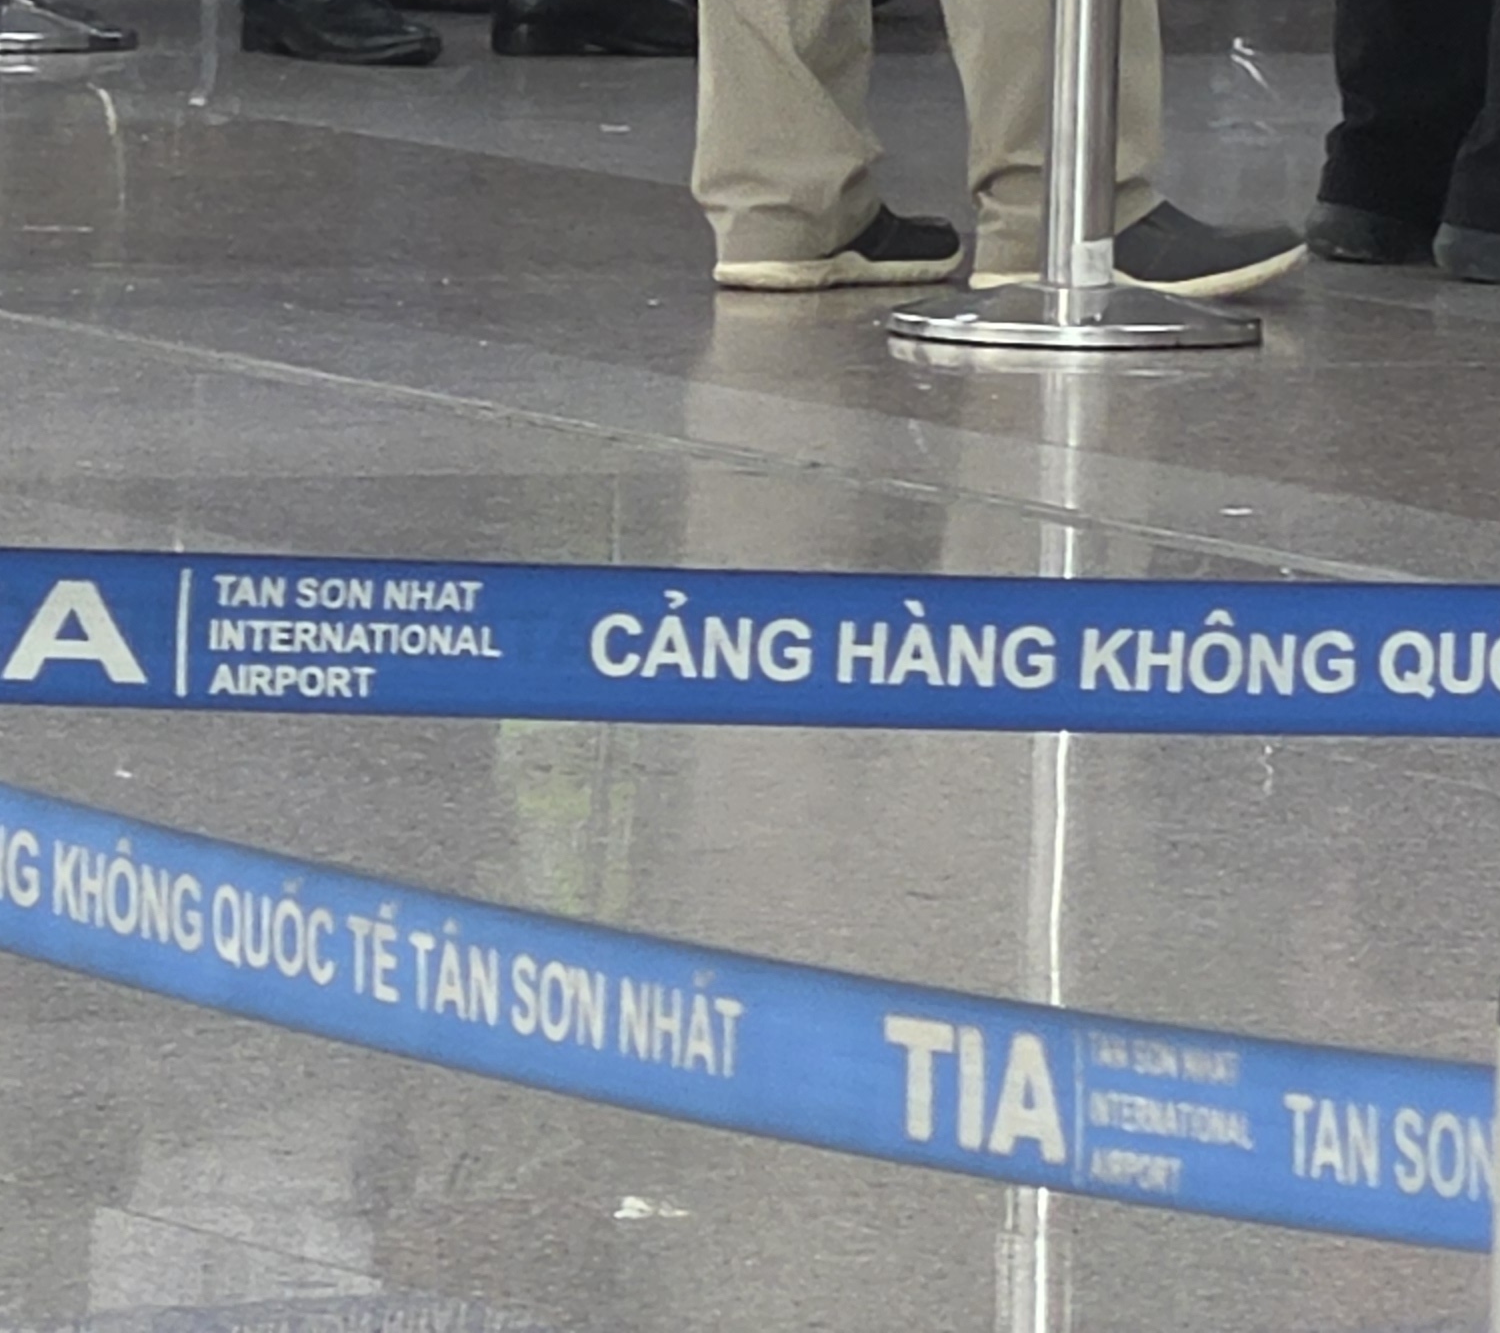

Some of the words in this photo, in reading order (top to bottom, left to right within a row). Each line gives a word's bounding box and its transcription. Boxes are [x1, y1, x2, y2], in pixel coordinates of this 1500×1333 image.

[208, 619, 503, 659] INTERNATIONAL
[212, 574, 286, 609] TAN
[295, 575, 374, 610] SON
[383, 579, 484, 612] NHAT
[207, 663, 378, 698] AIRPORT
[589, 589, 813, 683] CẢNG
[836, 599, 1056, 691] HÀNG
[1079, 608, 1357, 695] KHÔNG
[52, 836, 204, 952] KHÔNG
[212, 877, 336, 987] QUỐC
[346, 900, 400, 1003] TẾ
[408, 916, 498, 1027] TÂN
[510, 953, 606, 1050] SƠN
[617, 969, 744, 1078] NHẤT
[883, 1014, 1067, 1165] TIA
[1283, 1092, 1381, 1188] TAN
